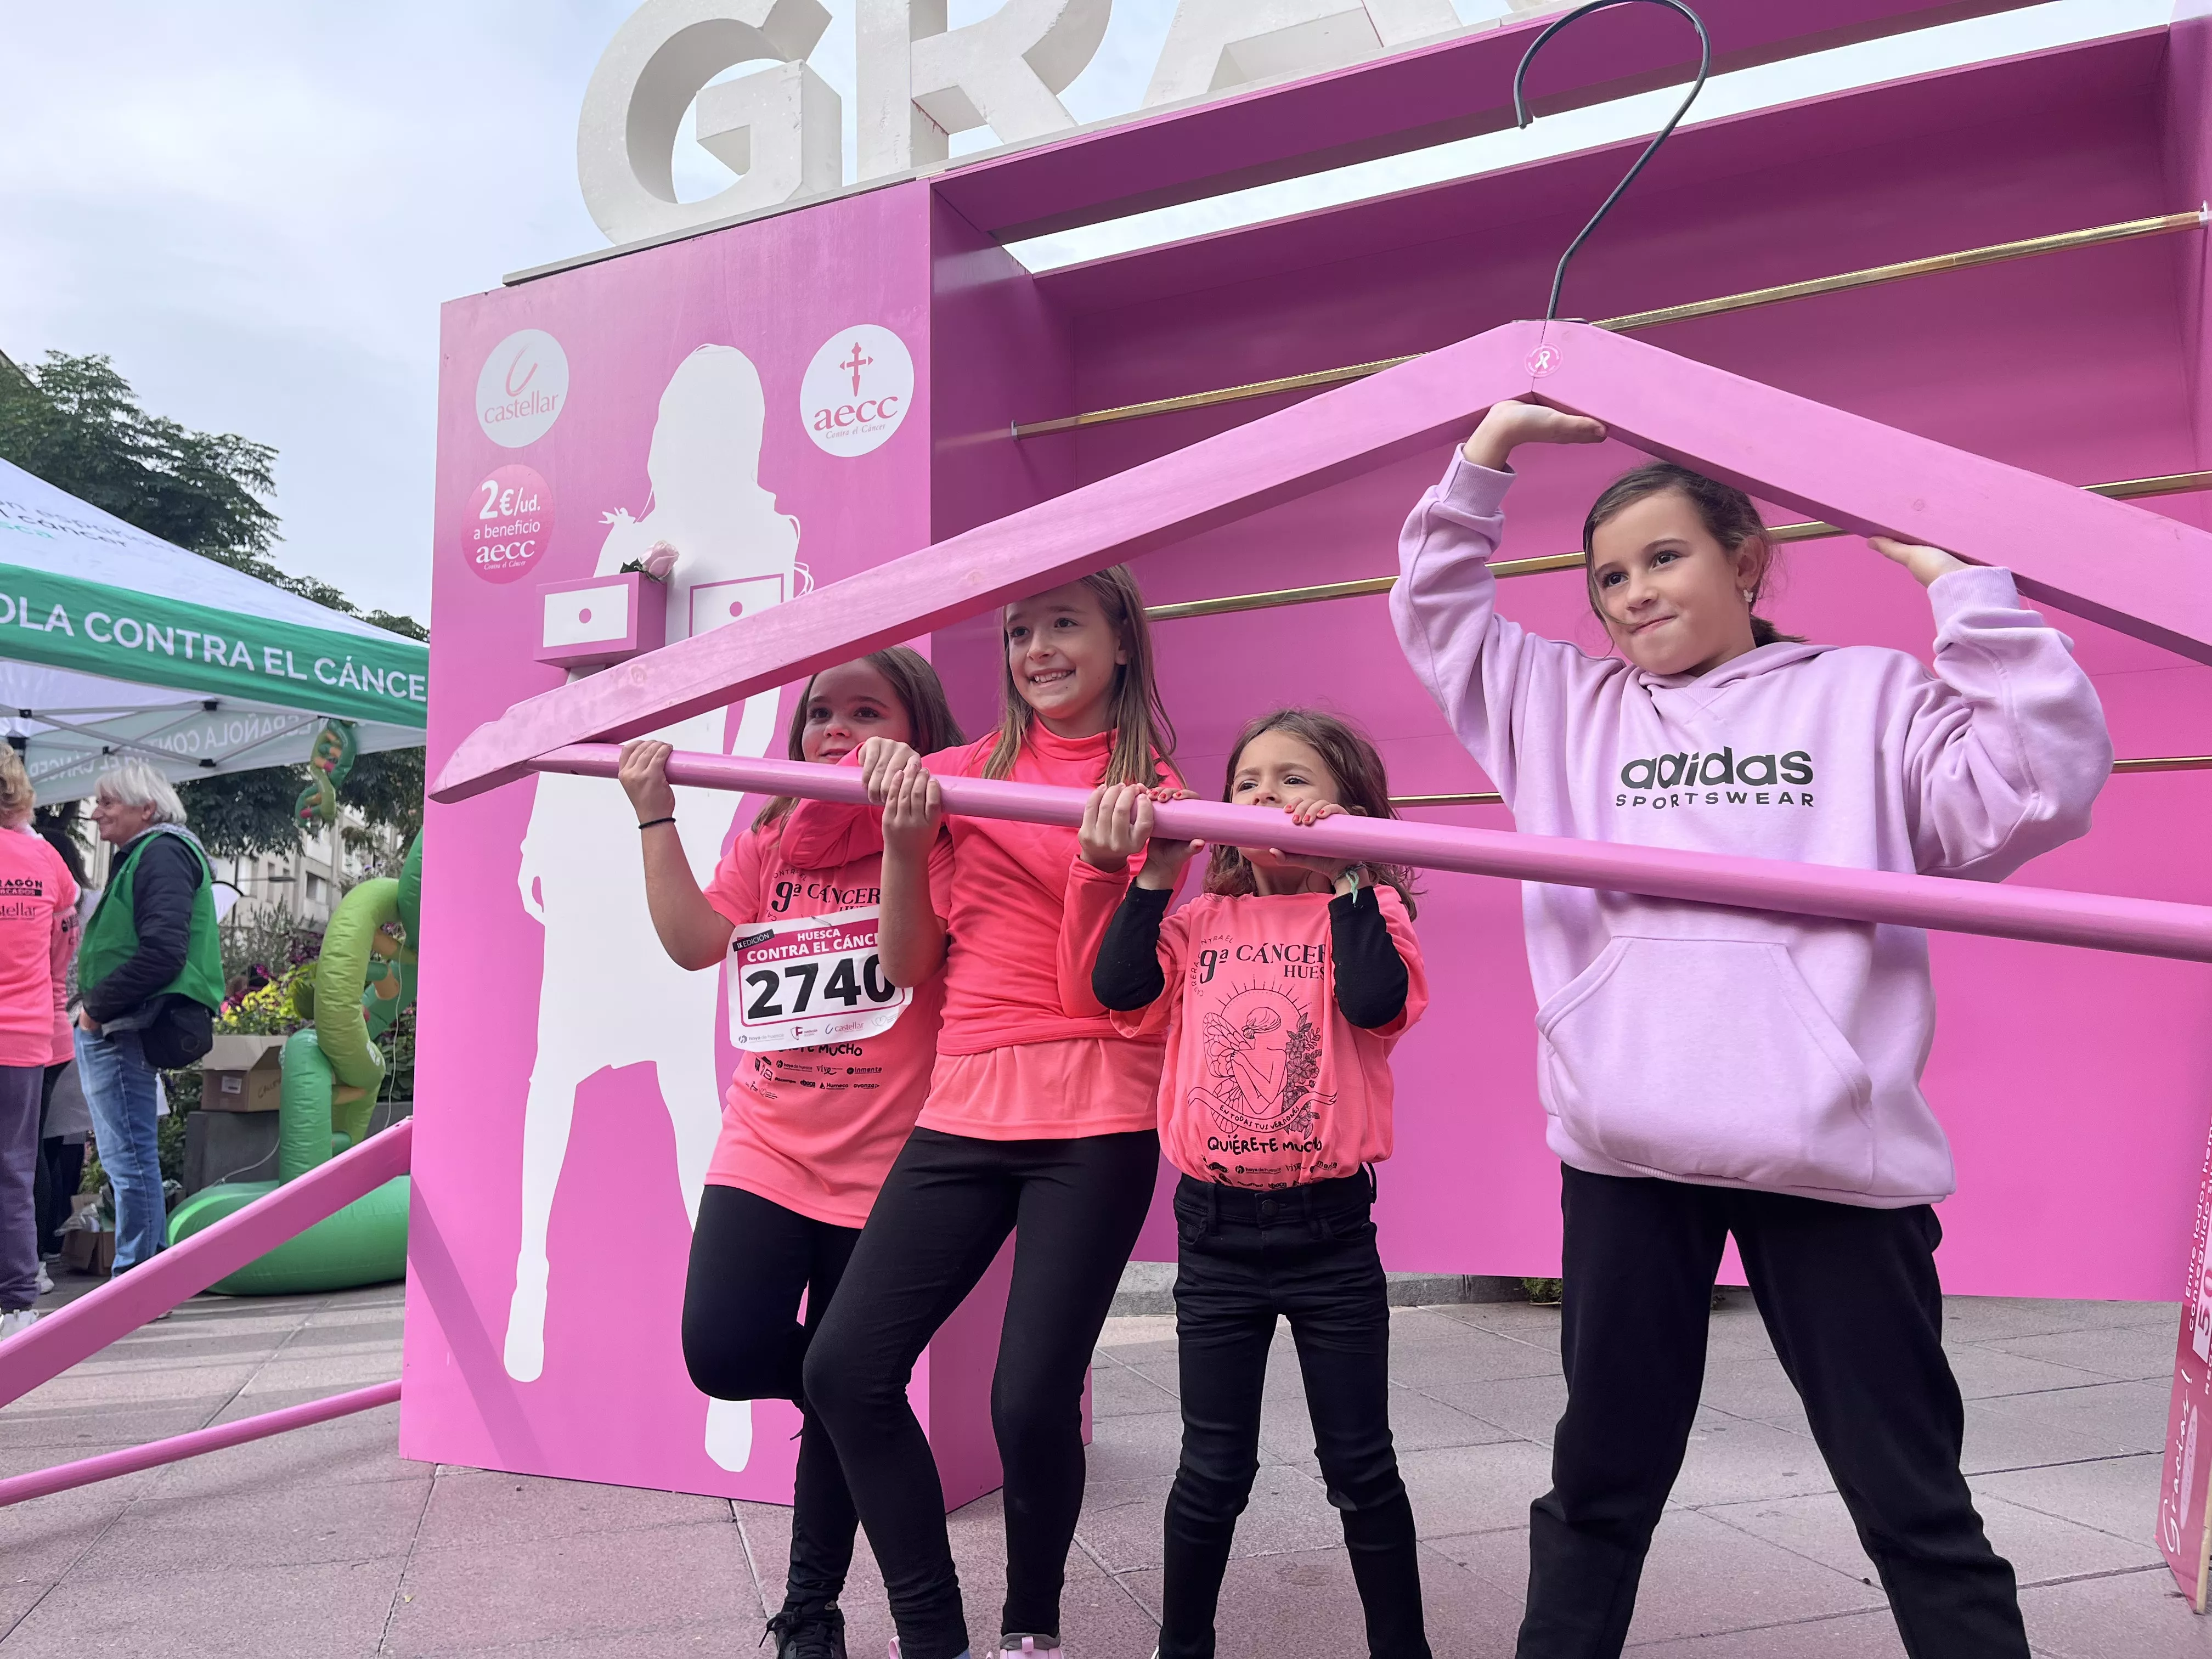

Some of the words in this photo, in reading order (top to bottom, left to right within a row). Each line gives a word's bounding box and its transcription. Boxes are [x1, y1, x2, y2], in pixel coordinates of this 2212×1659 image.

[484, 390, 559, 424] castellar
[814, 396, 898, 431] aecc
[826, 430, 849, 439] Contra
[852, 426, 859, 435] el
[861, 423, 887, 433] Cáncer
[0, 521, 55, 541] sca
[473, 529, 481, 540] a
[484, 518, 540, 539] beneficio
[476, 540, 535, 564] aecc
[84, 611, 256, 672] CONTRA
[263, 646, 308, 681] EL
[1621, 746, 1814, 789] adidas
[1616, 791, 1814, 809] SPORTSWEAR
[0, 876, 42, 888] AGÓN
[771, 882, 803, 912] 9ª
[807, 883, 881, 905] CÁNCER
[742, 933, 770, 947] EDICIÓN
[797, 928, 840, 942] HUESCA
[747, 944, 809, 963] CONTRA
[812, 941, 829, 953] EL
[1200, 949, 1229, 984] 9ª
[745, 953, 896, 1019] 2740
[834, 1022, 864, 1032] castellar
[819, 1043, 862, 1057] MUCHO
[1220, 1105, 1229, 1115] EN
[1230, 1113, 1252, 1127] TODAS
[1207, 1134, 1278, 1155] QUIÉRETE
[2185, 1246, 2197, 1298] Entre
[2193, 1181, 2206, 1239] todos
[2189, 1201, 2210, 1332] conseguido
